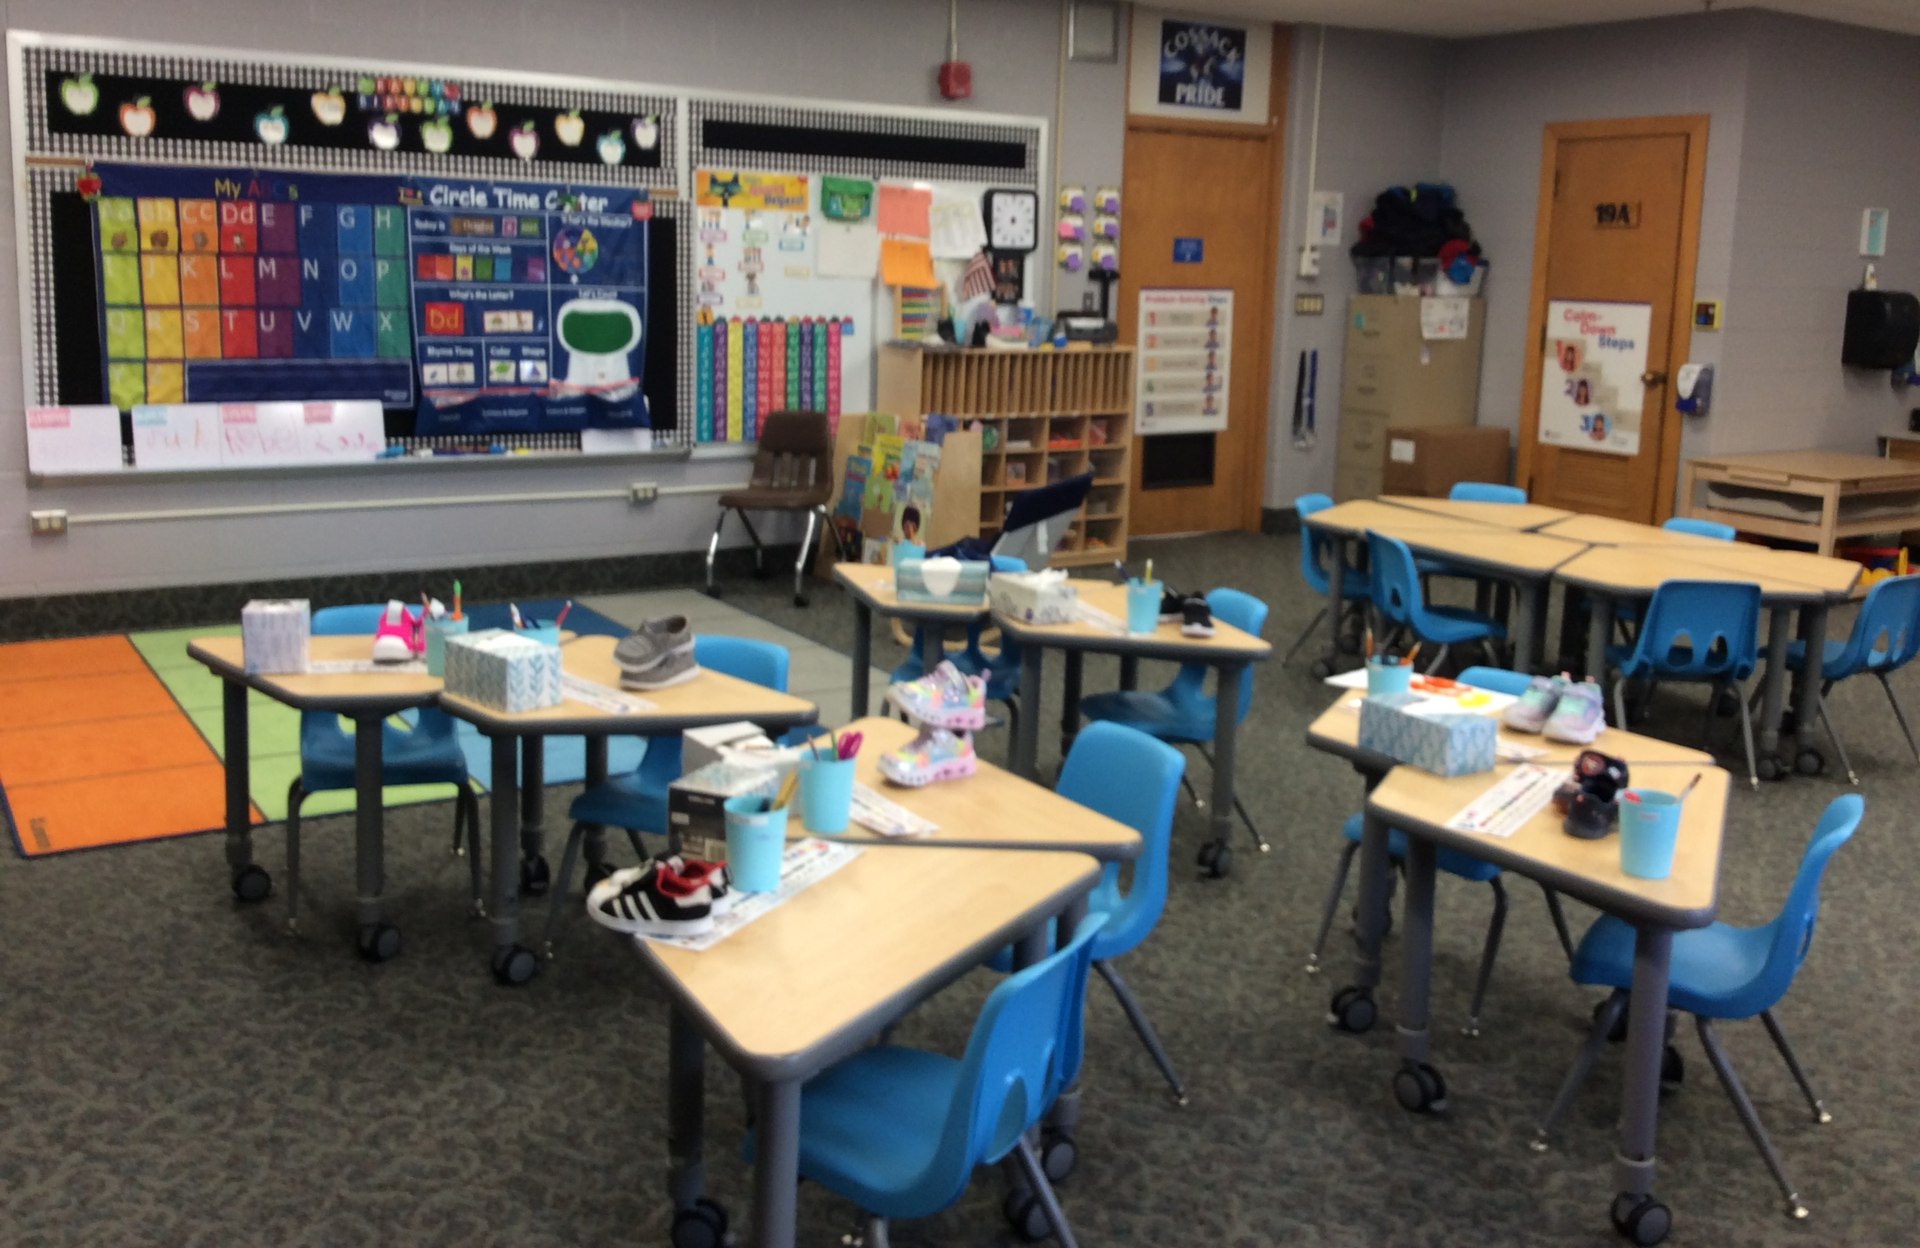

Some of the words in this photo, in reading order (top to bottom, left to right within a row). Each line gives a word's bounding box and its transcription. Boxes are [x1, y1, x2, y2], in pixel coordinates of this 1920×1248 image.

[1176, 83, 1225, 107] PRIDE
[215, 178, 241, 200] My
[430, 184, 488, 208] Circle
[493, 187, 539, 211] Time
[545, 190, 609, 213] Cter
[182, 202, 212, 224] Cc
[221, 202, 254, 225] Dd
[262, 203, 275, 227] E
[301, 204, 313, 228] F
[339, 206, 356, 229] G
[376, 207, 391, 230] H
[183, 257, 197, 279] K
[221, 257, 234, 279] L
[258, 257, 277, 280] M
[303, 258, 319, 281] N
[341, 259, 357, 282] O
[377, 259, 390, 282] P
[186, 310, 200, 333] S
[223, 310, 238, 333] T
[259, 310, 275, 332] U
[297, 310, 312, 333] V
[332, 310, 353, 332] W
[380, 311, 392, 332] X
[429, 308, 460, 330] Dd
[1598, 335, 1635, 352] Steps
